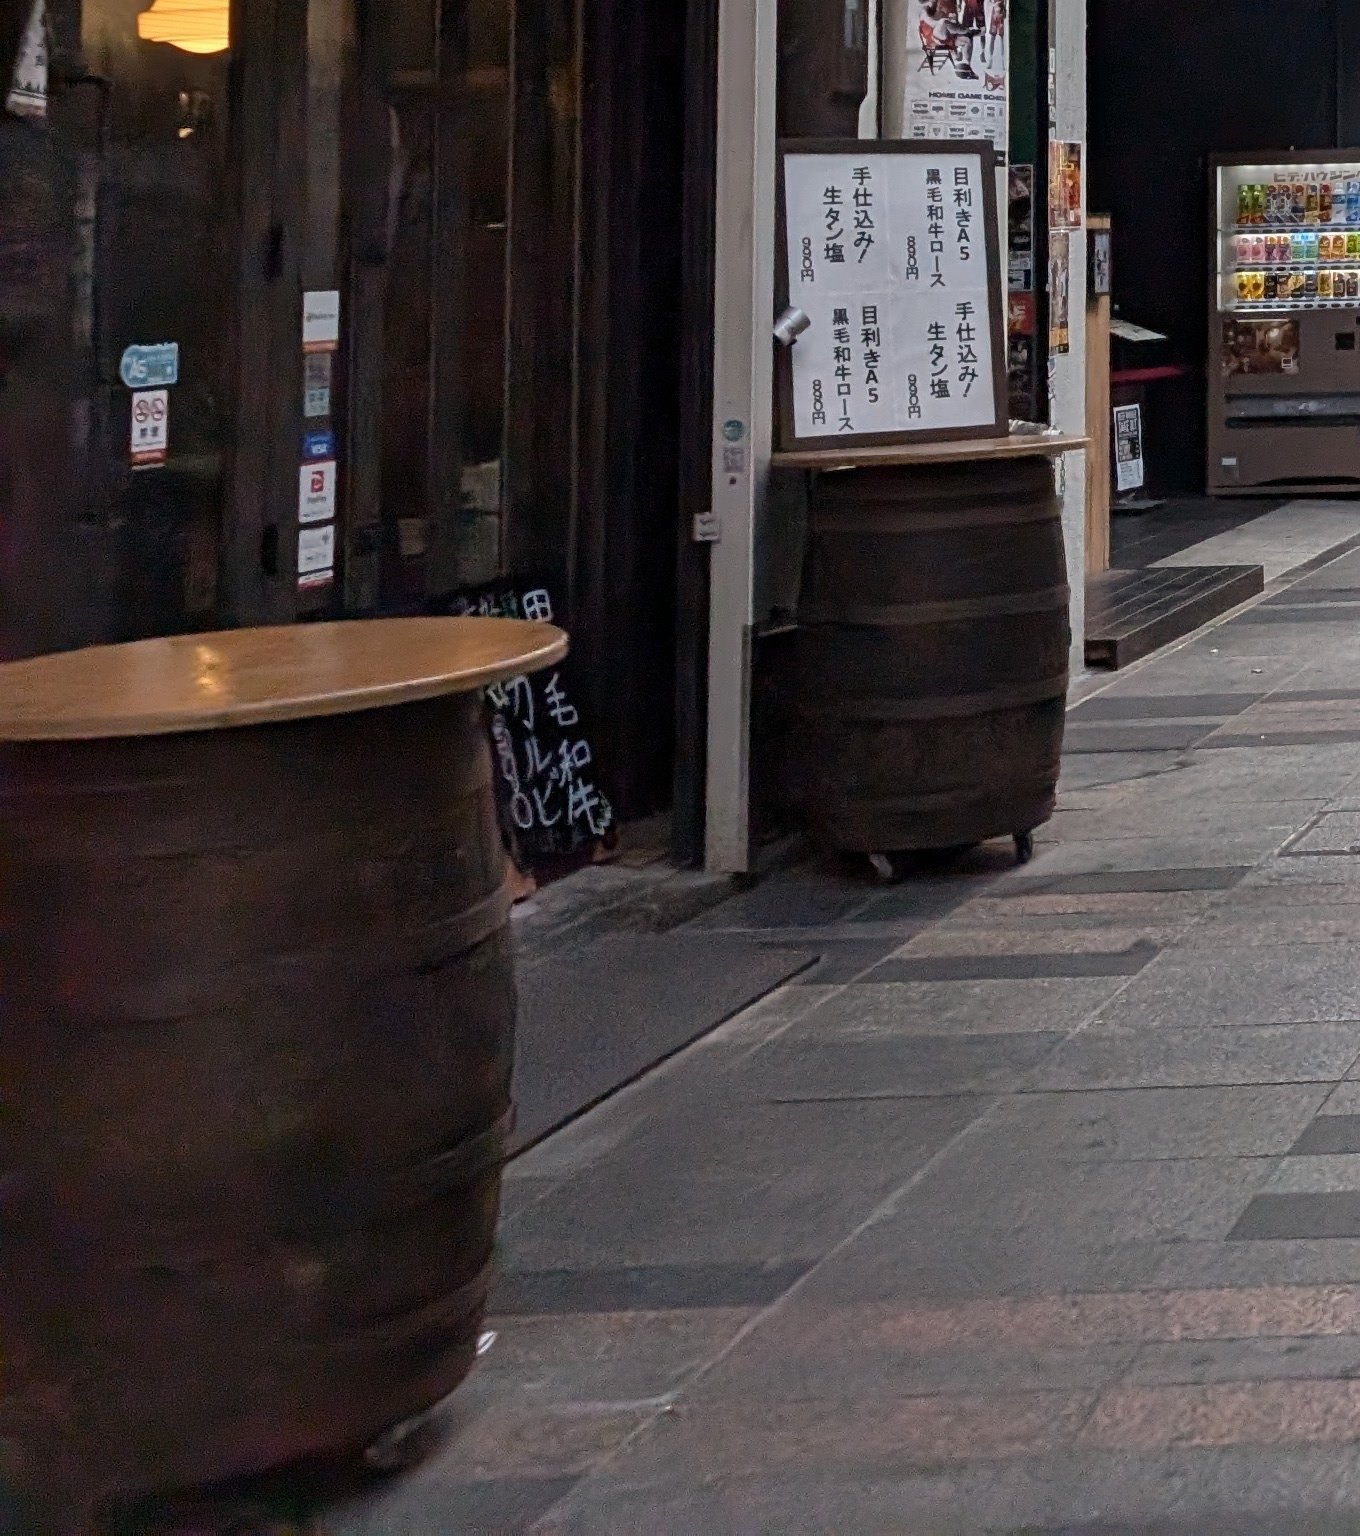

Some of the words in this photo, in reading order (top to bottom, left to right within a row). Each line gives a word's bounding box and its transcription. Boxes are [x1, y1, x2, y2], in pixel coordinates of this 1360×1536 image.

[822, 185, 846, 264] 生タン塩
[852, 166, 875, 264] 手仕込み!
[925, 168, 946, 288] 黒毛和牛ロース
[953, 167, 973, 261] 目利きA5
[800, 237, 815, 282] 990円
[906, 235, 919, 280] 890円
[832, 308, 855, 432] 黒毛和牛ロース
[861, 305, 881, 404] 目利きA5
[926, 321, 951, 400] 生タン塩
[955, 301, 979, 399] 手仕込み!
[811, 379, 826, 425] 890円
[907, 374, 921, 419] 990円
